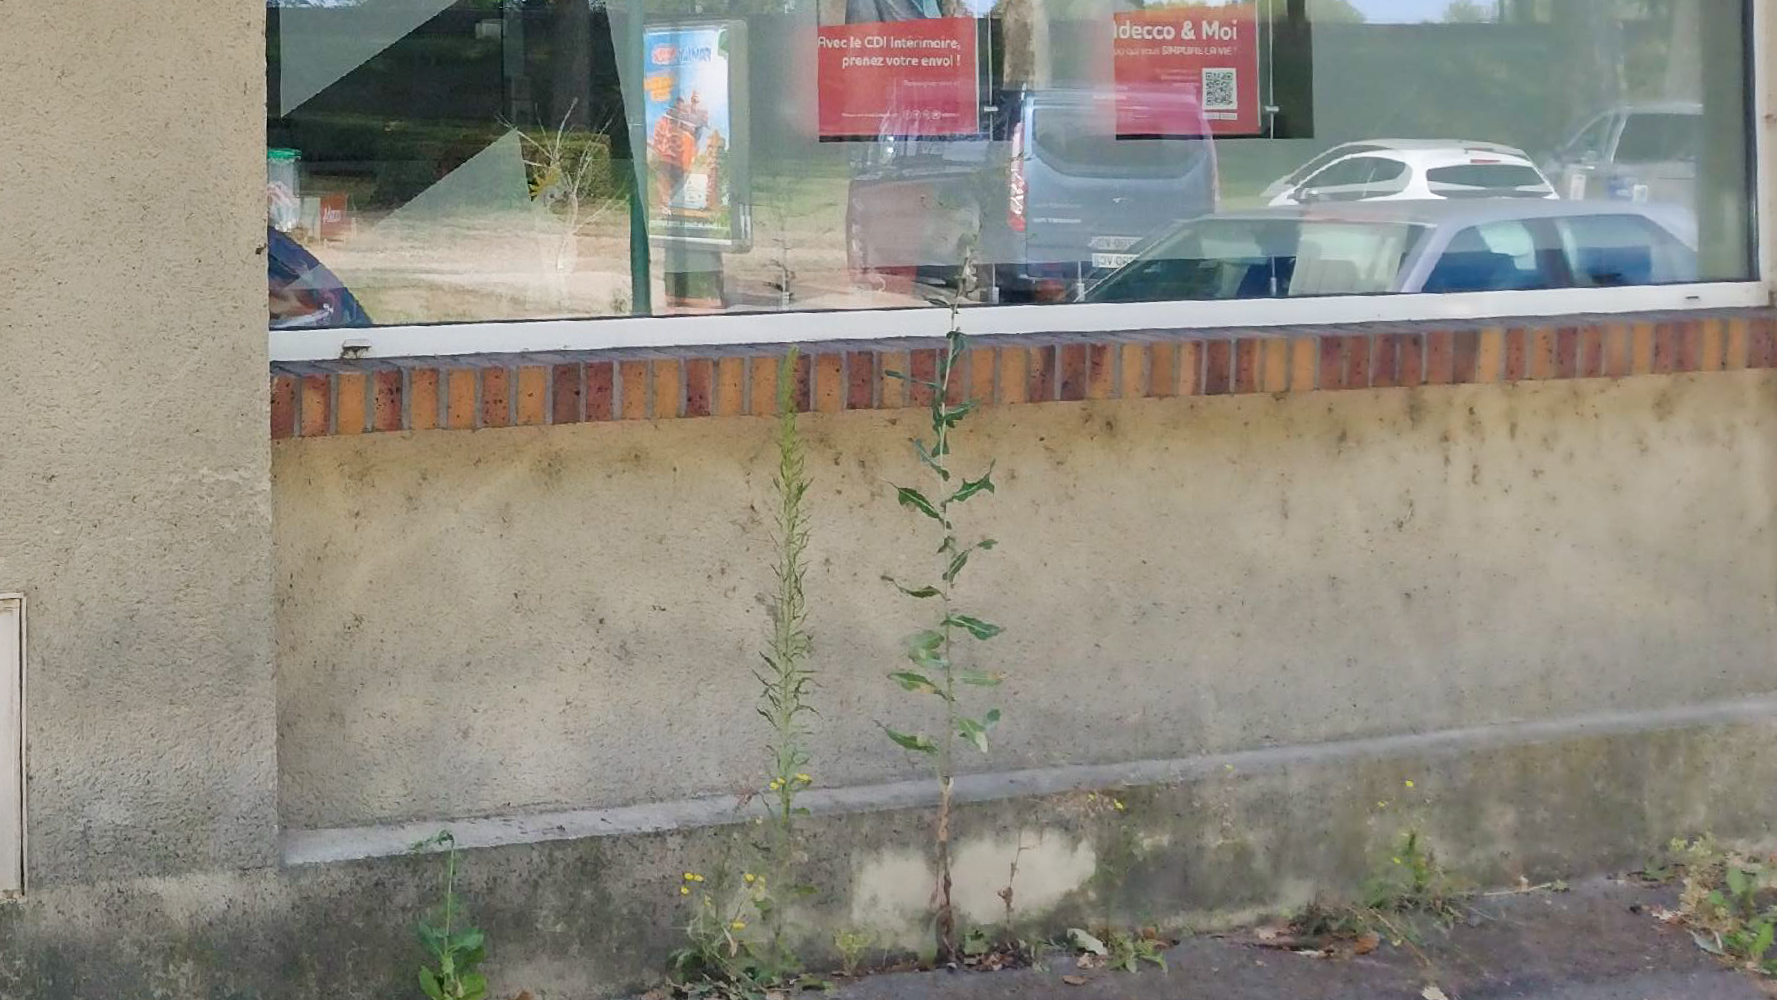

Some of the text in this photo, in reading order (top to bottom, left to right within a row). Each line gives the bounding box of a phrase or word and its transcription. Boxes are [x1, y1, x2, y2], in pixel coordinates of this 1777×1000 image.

[1181, 20, 1196, 40] &
[1202, 19, 1237, 41] Moi
[818, 36, 848, 49] Avec
[850, 36, 862, 49] le
[865, 36, 887, 49] CDI
[842, 55, 961, 69] prenez votre envol !
